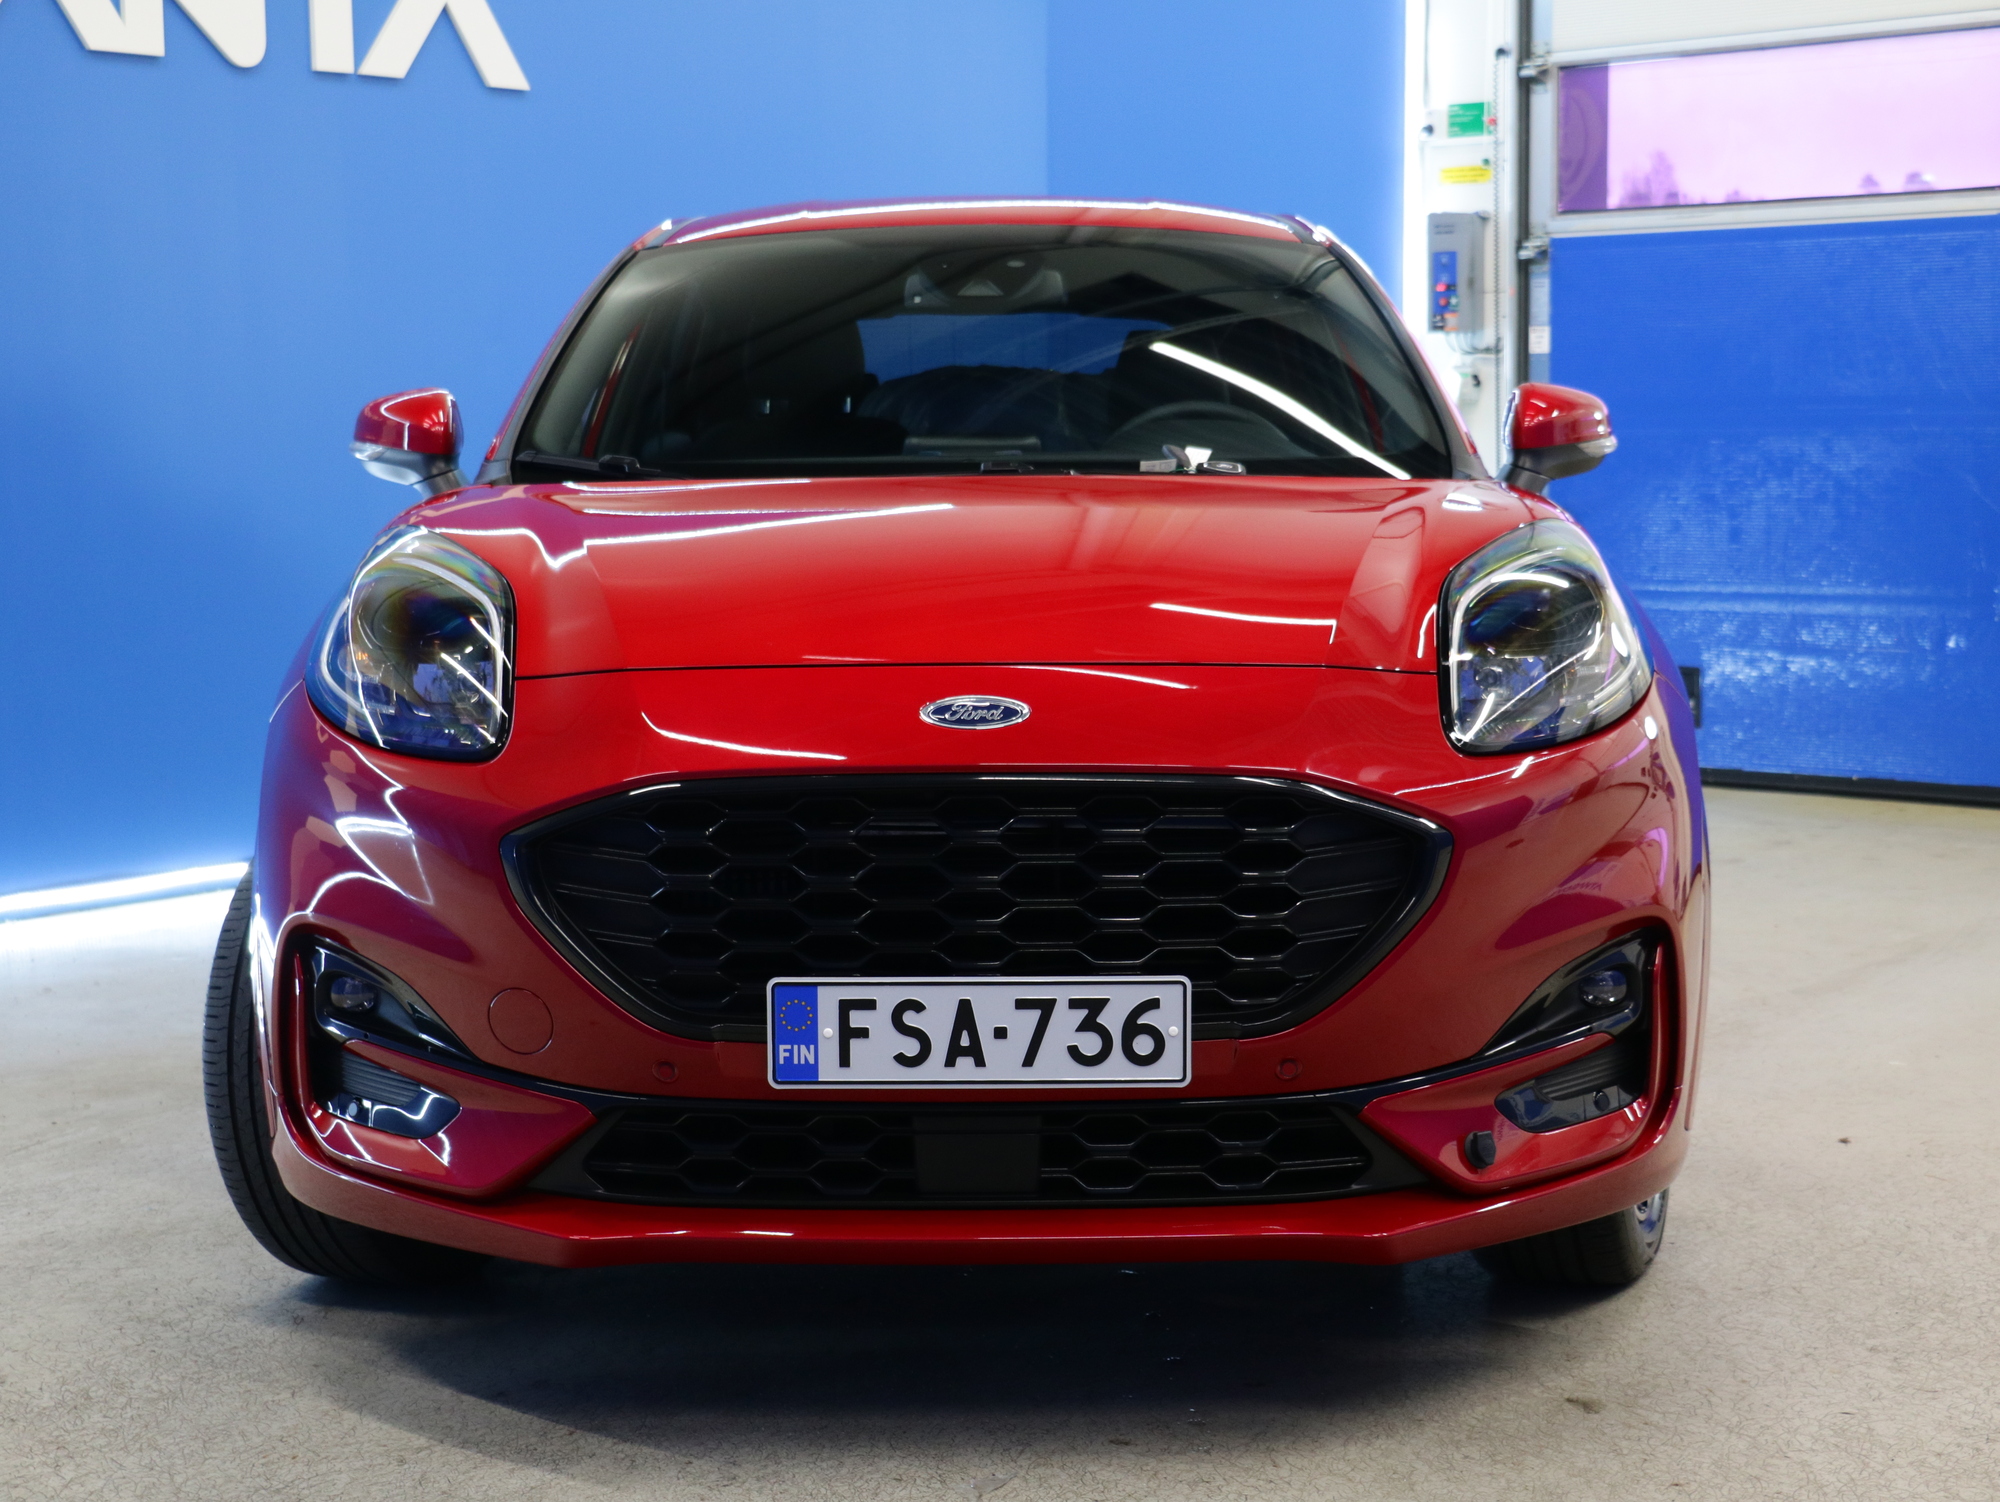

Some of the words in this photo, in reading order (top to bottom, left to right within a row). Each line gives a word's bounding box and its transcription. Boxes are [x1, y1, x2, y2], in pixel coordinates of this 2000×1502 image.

[943, 702, 1005, 721] Ford
[838, 996, 1166, 1068] FSA-736
[778, 1044, 816, 1065] FIN
